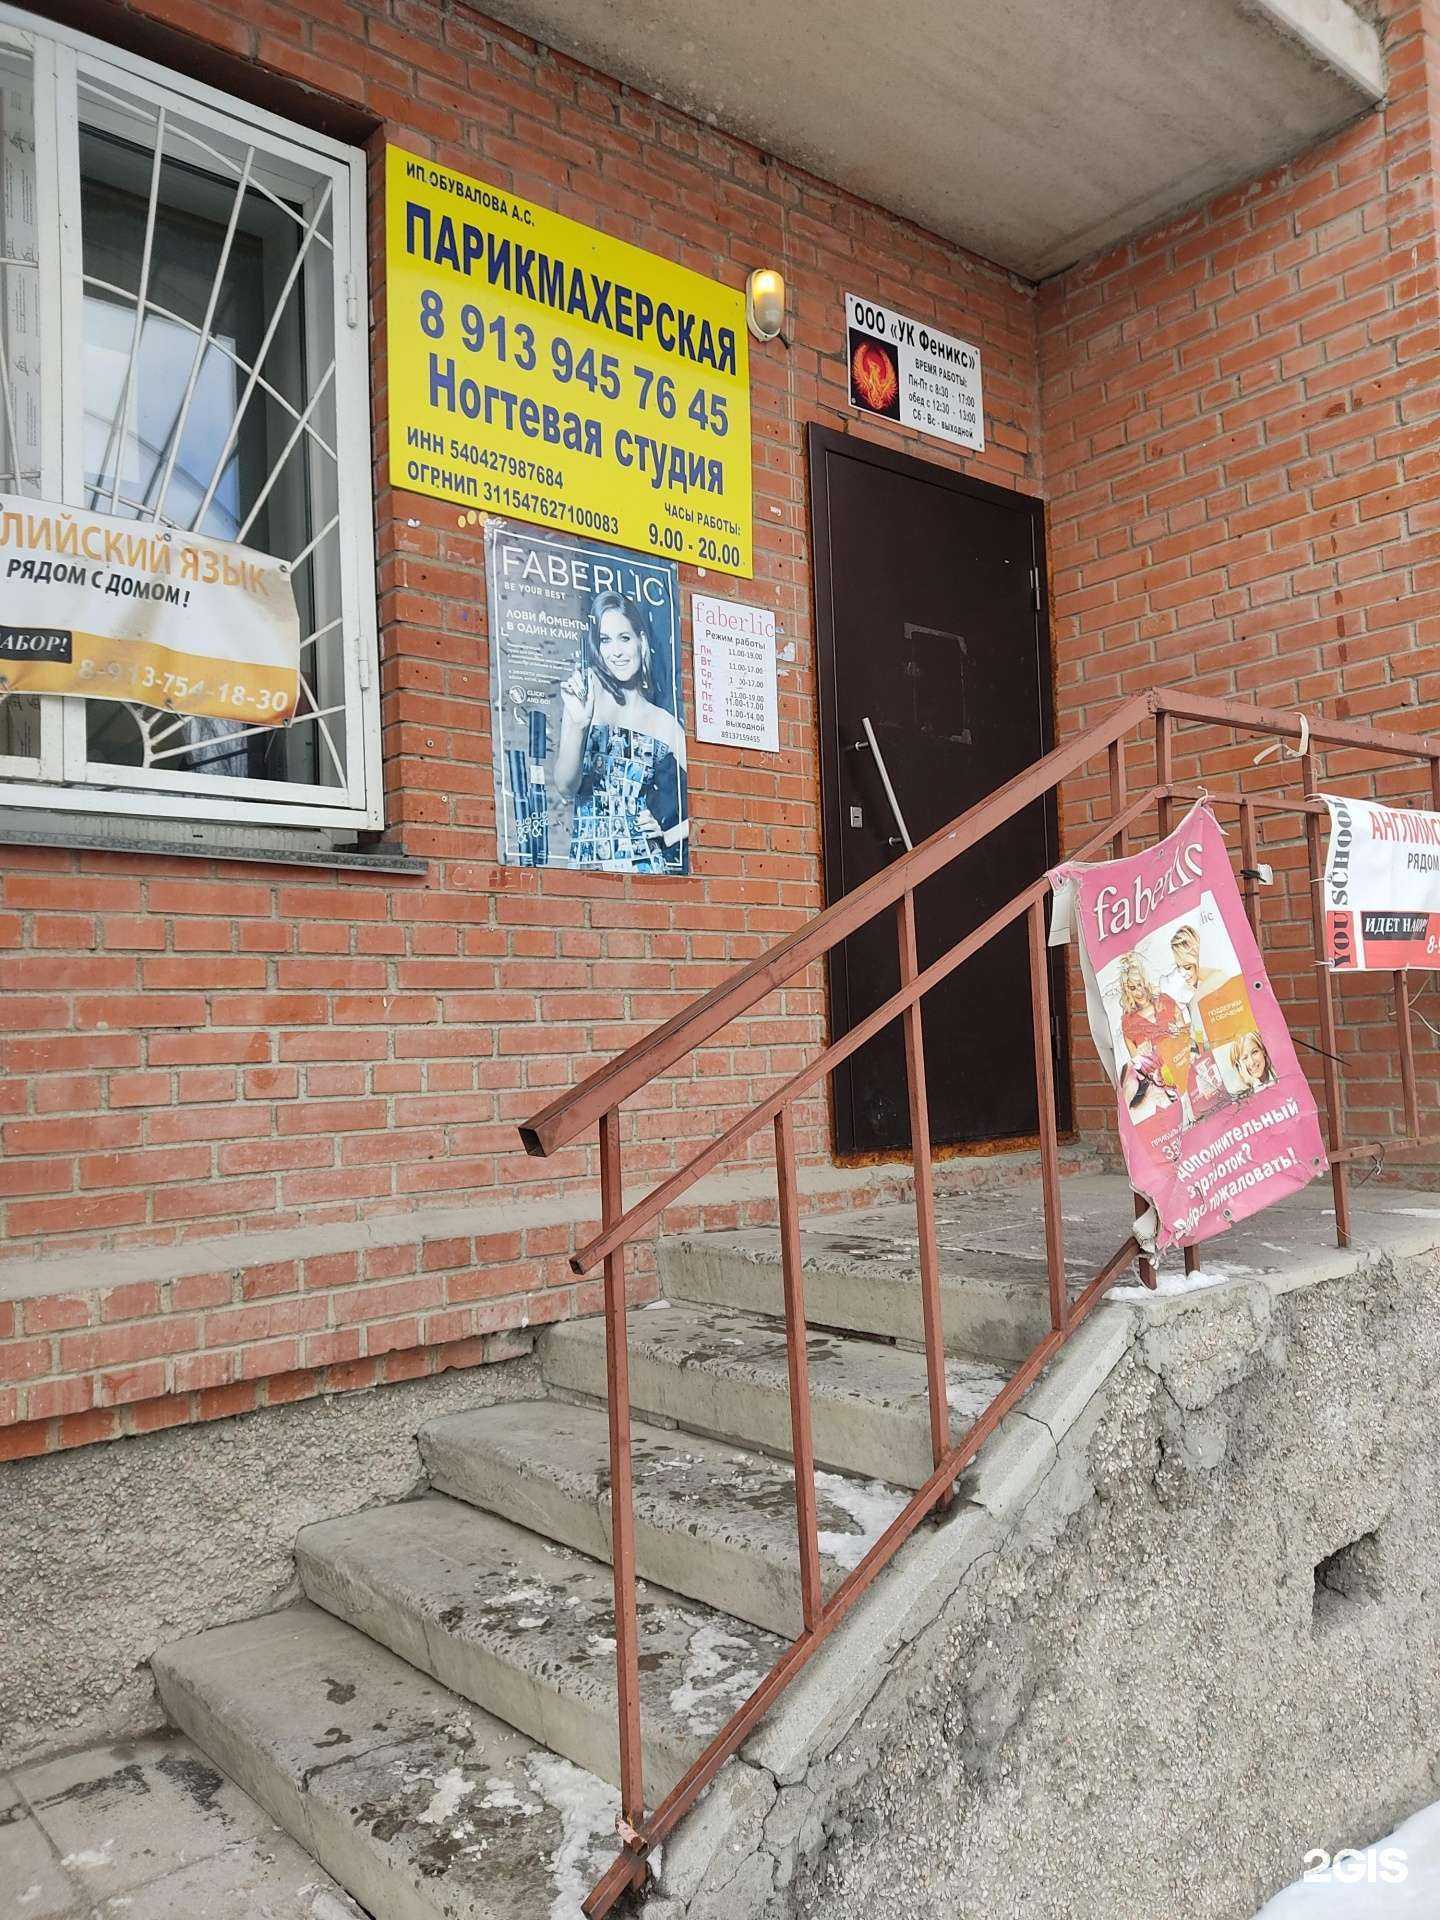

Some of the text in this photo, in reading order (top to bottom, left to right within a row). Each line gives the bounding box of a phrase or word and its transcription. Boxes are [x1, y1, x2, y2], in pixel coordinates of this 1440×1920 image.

[429, 171, 508, 216] ОБУВАЛОВА
[512, 205, 535, 226] А.С.
[406, 201, 736, 375] ПАРИКМАХЕРСКАЯ
[855, 302, 975, 370] ООО «УК Феникс»
[420, 289, 729, 437] 8 913 945 76 45
[915, 358, 937, 376] ВРЕМЯ
[908, 392, 925, 408] обед
[932, 400, 950, 415] 12:30
[935, 383, 949, 398] 8:30
[958, 393, 975, 408] 17:00
[428, 352, 723, 495] Ногтевая студия
[912, 408, 922, 421] Сб
[927, 413, 936, 426] Вс
[407, 426, 564, 489] ИНН 540427987684
[407, 460, 619, 535] ОГРНИП 311547627100083
[664, 502, 741, 536] ЧАСЫ РАБОТЫ:
[649, 523, 683, 551] 9.00
[698, 537, 740, 567] 20.00
[6, 558, 86, 587] РЯДОМ
[105, 574, 191, 608] ДОМОМ!
[179, 545, 271, 596] ЯЗЫК
[502, 545, 665, 606] FABERLIC
[504, 582, 566, 600] BE YOUR BEST
[507, 622, 578, 640] В ОДИН КЛИК
[695, 602, 774, 637] faberlic
[0, 633, 67, 652] АБОР!
[706, 630, 765, 650] Режим работы
[701, 657, 711, 666] Вт
[702, 714, 765, 732] Вс выходной
[1369, 811, 1440, 846] АНГЛИЙС
[1408, 853, 1439, 873] РЯДОМ
[1333, 912, 1351, 968] YOU
[1365, 917, 1400, 935] ИДЕТ
